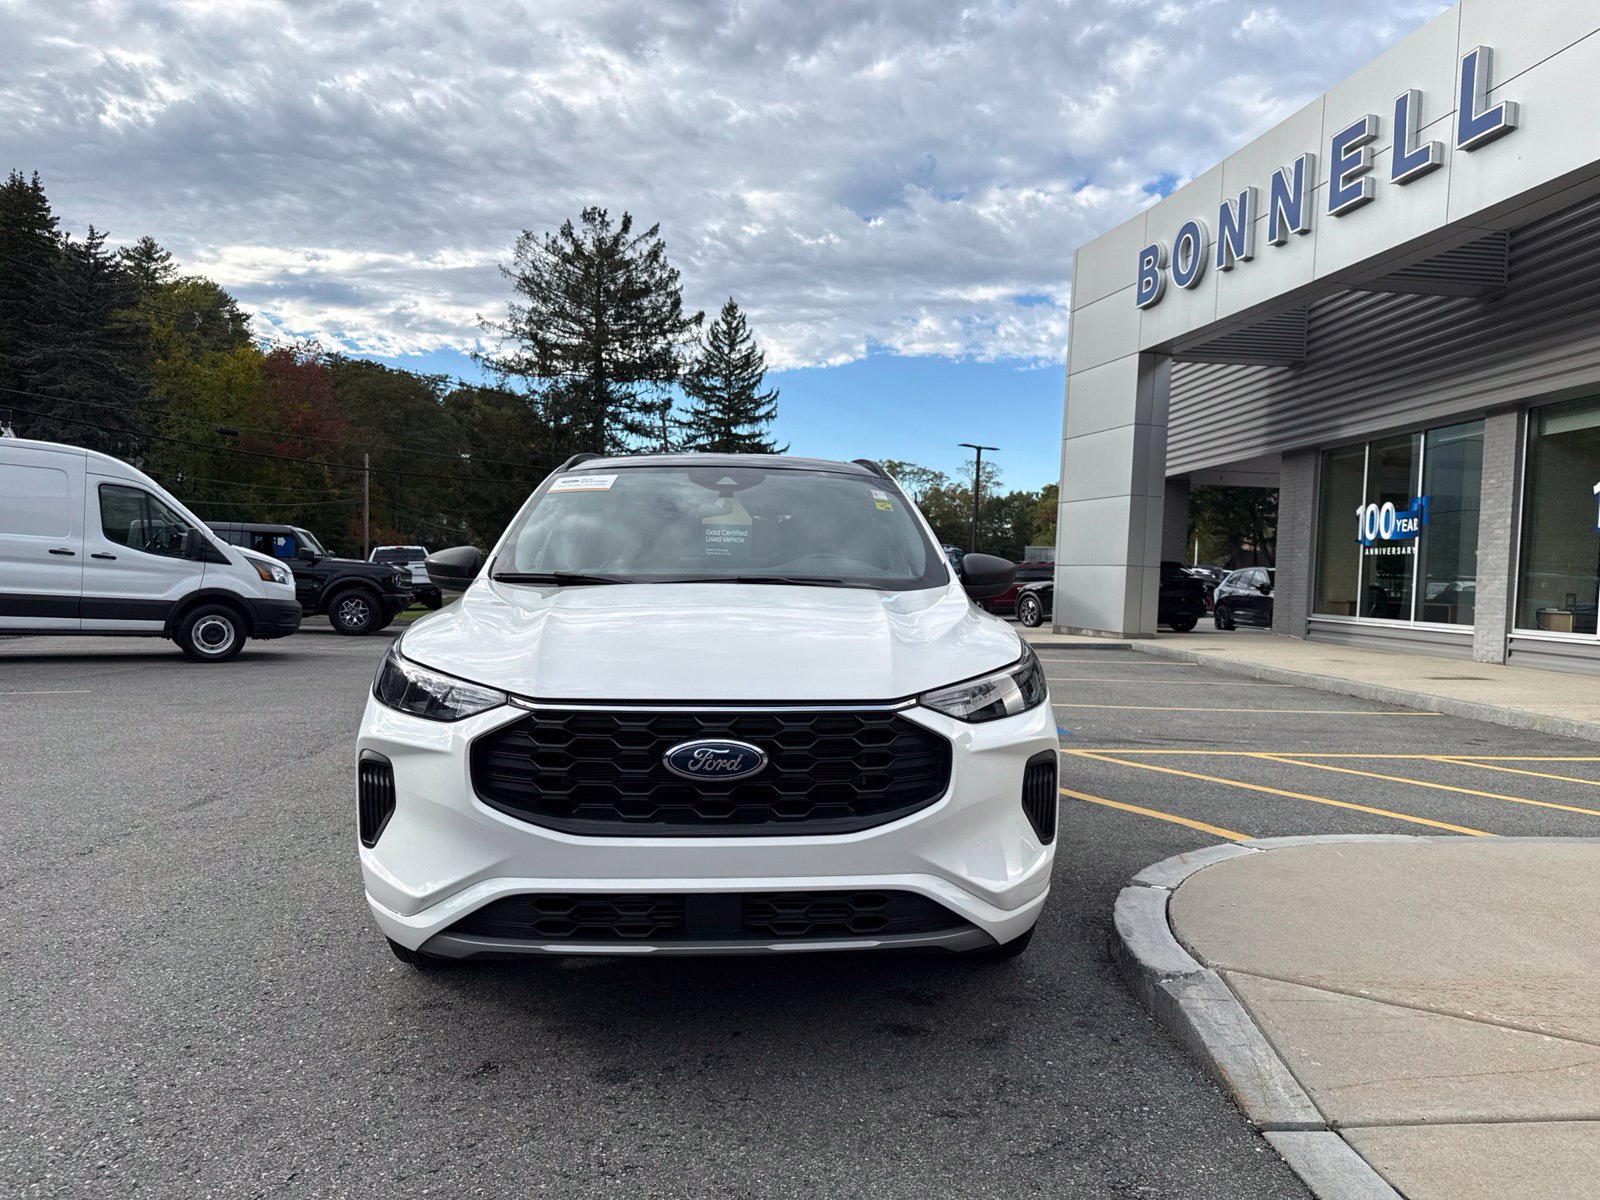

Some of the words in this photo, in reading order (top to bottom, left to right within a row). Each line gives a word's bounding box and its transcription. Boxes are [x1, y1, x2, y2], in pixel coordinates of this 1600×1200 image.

[1136, 45, 1518, 309] BONNELL
[721, 529, 748, 537] Certified
[1356, 501, 1396, 540] 100
[687, 748, 744, 771] Ford
